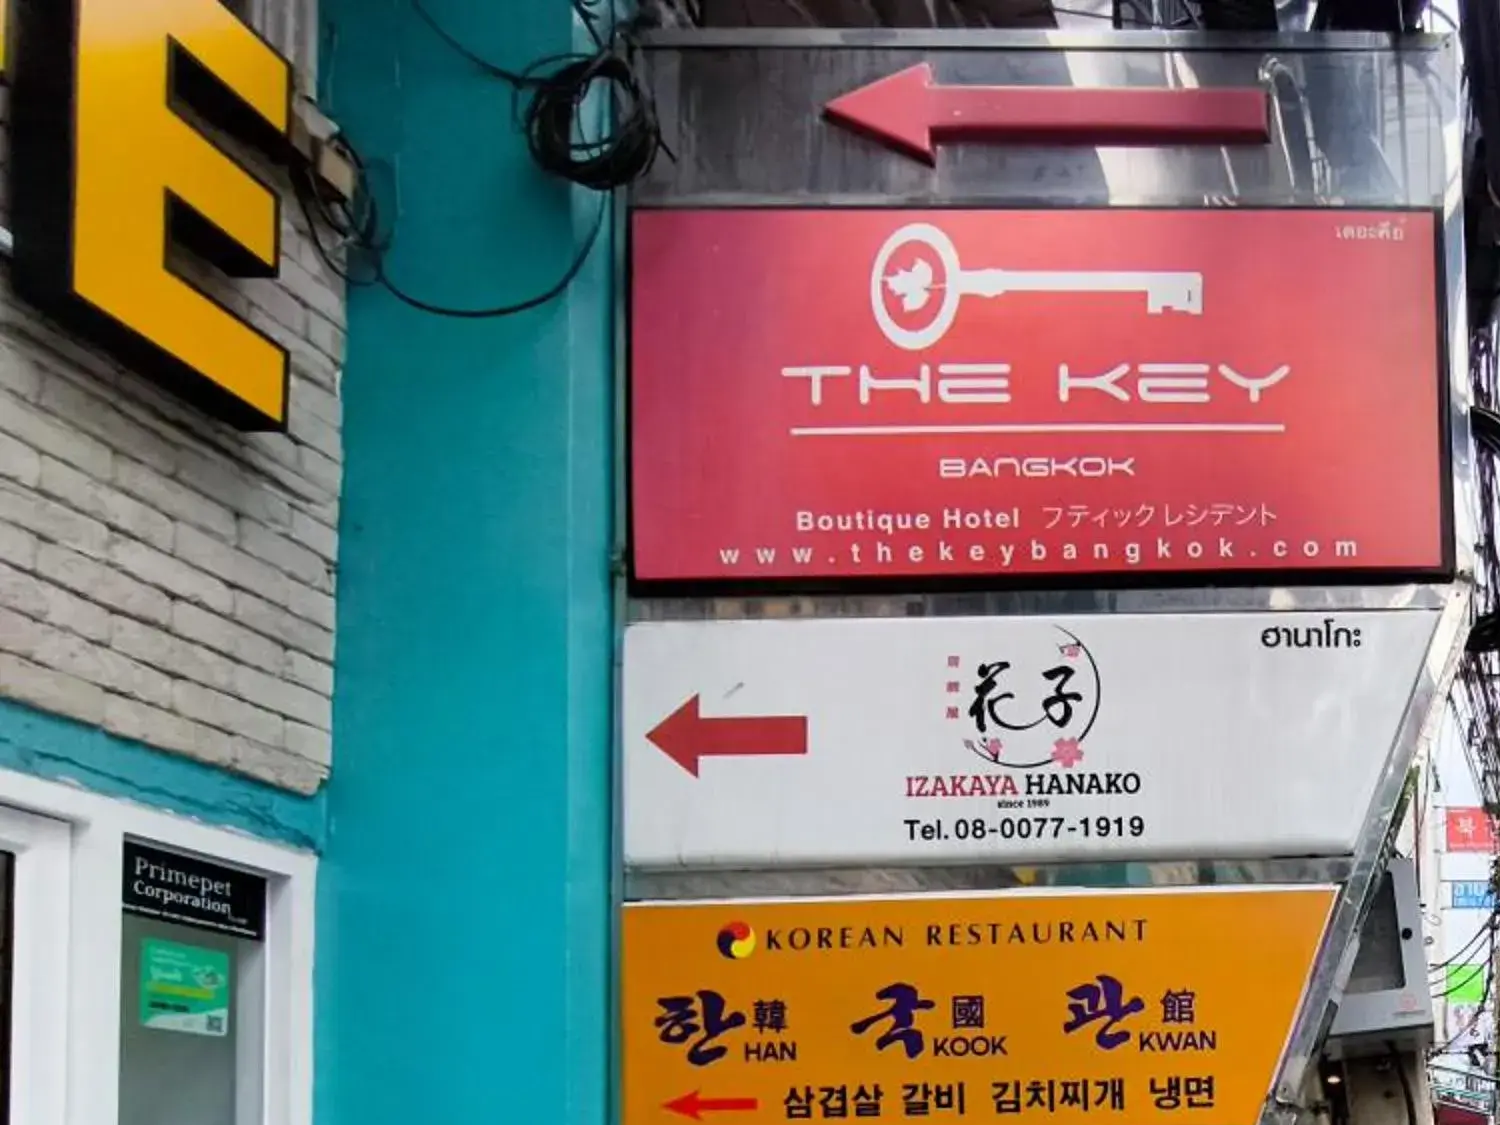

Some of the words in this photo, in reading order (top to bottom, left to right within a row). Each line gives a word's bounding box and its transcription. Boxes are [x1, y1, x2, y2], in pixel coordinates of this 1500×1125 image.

[781, 363, 1012, 405] THE
[1058, 362, 1291, 403] KEY
[939, 457, 1135, 478] BANGKOK
[796, 510, 930, 535] Boutique
[943, 507, 1019, 529] Hotel
[1260, 618, 1361, 648] ฮานาโกะ
[906, 775, 1019, 797] IZAKAYA
[1024, 773, 1141, 796] HANAKO
[904, 819, 949, 841] Tel.
[954, 816, 1145, 840] 08-0077-1919
[134, 856, 232, 896] Primepet
[133, 880, 232, 914] Corporation
[766, 926, 903, 951] KOREAN
[926, 919, 1147, 946] RESTAURANT
[655, 989, 746, 1066] 한
[851, 982, 936, 1060] 국
[1063, 974, 1146, 1050] 관
[745, 1041, 797, 1062] HAN
[934, 1035, 1008, 1057] KOOK
[1139, 1030, 1217, 1052] KWAN
[784, 1083, 884, 1121] 삼겹살
[902, 1081, 966, 1117] 갈비
[992, 1077, 1125, 1114] 김치찌개
[1148, 1075, 1217, 1110] 냉면
